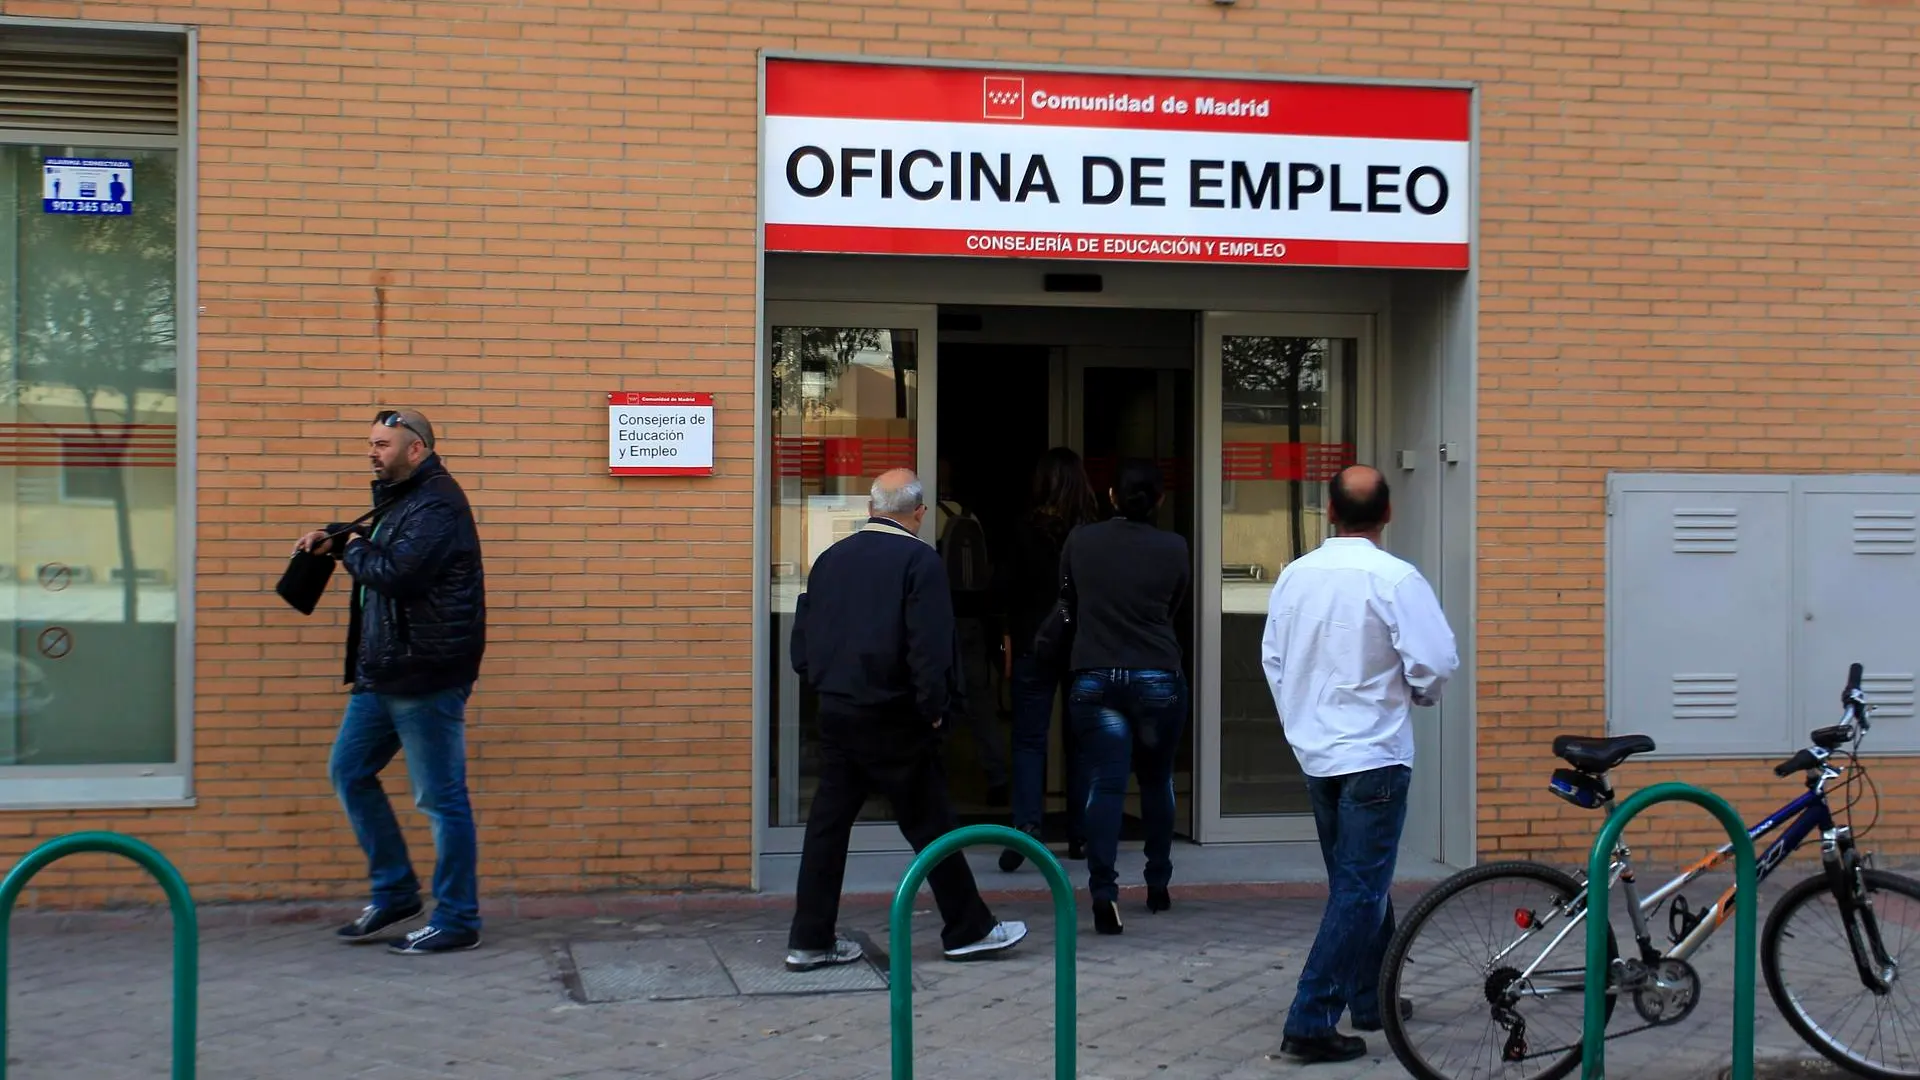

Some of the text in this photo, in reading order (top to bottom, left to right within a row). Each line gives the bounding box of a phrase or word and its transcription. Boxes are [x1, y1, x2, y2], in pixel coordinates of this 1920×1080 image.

[1030, 89, 1270, 118] Comunidad de Madrid
[786, 145, 1449, 215] OFICINA DE EMPLEO
[52, 201, 74, 211] 902
[76, 201, 99, 212] 365
[966, 234, 1286, 258] CONSEJERÍA DE EDUCACIÓN Y EMPLEO
[618, 413, 706, 427] Consejería de
[619, 429, 684, 441] Educación
[619, 445, 678, 459] y Empleo
